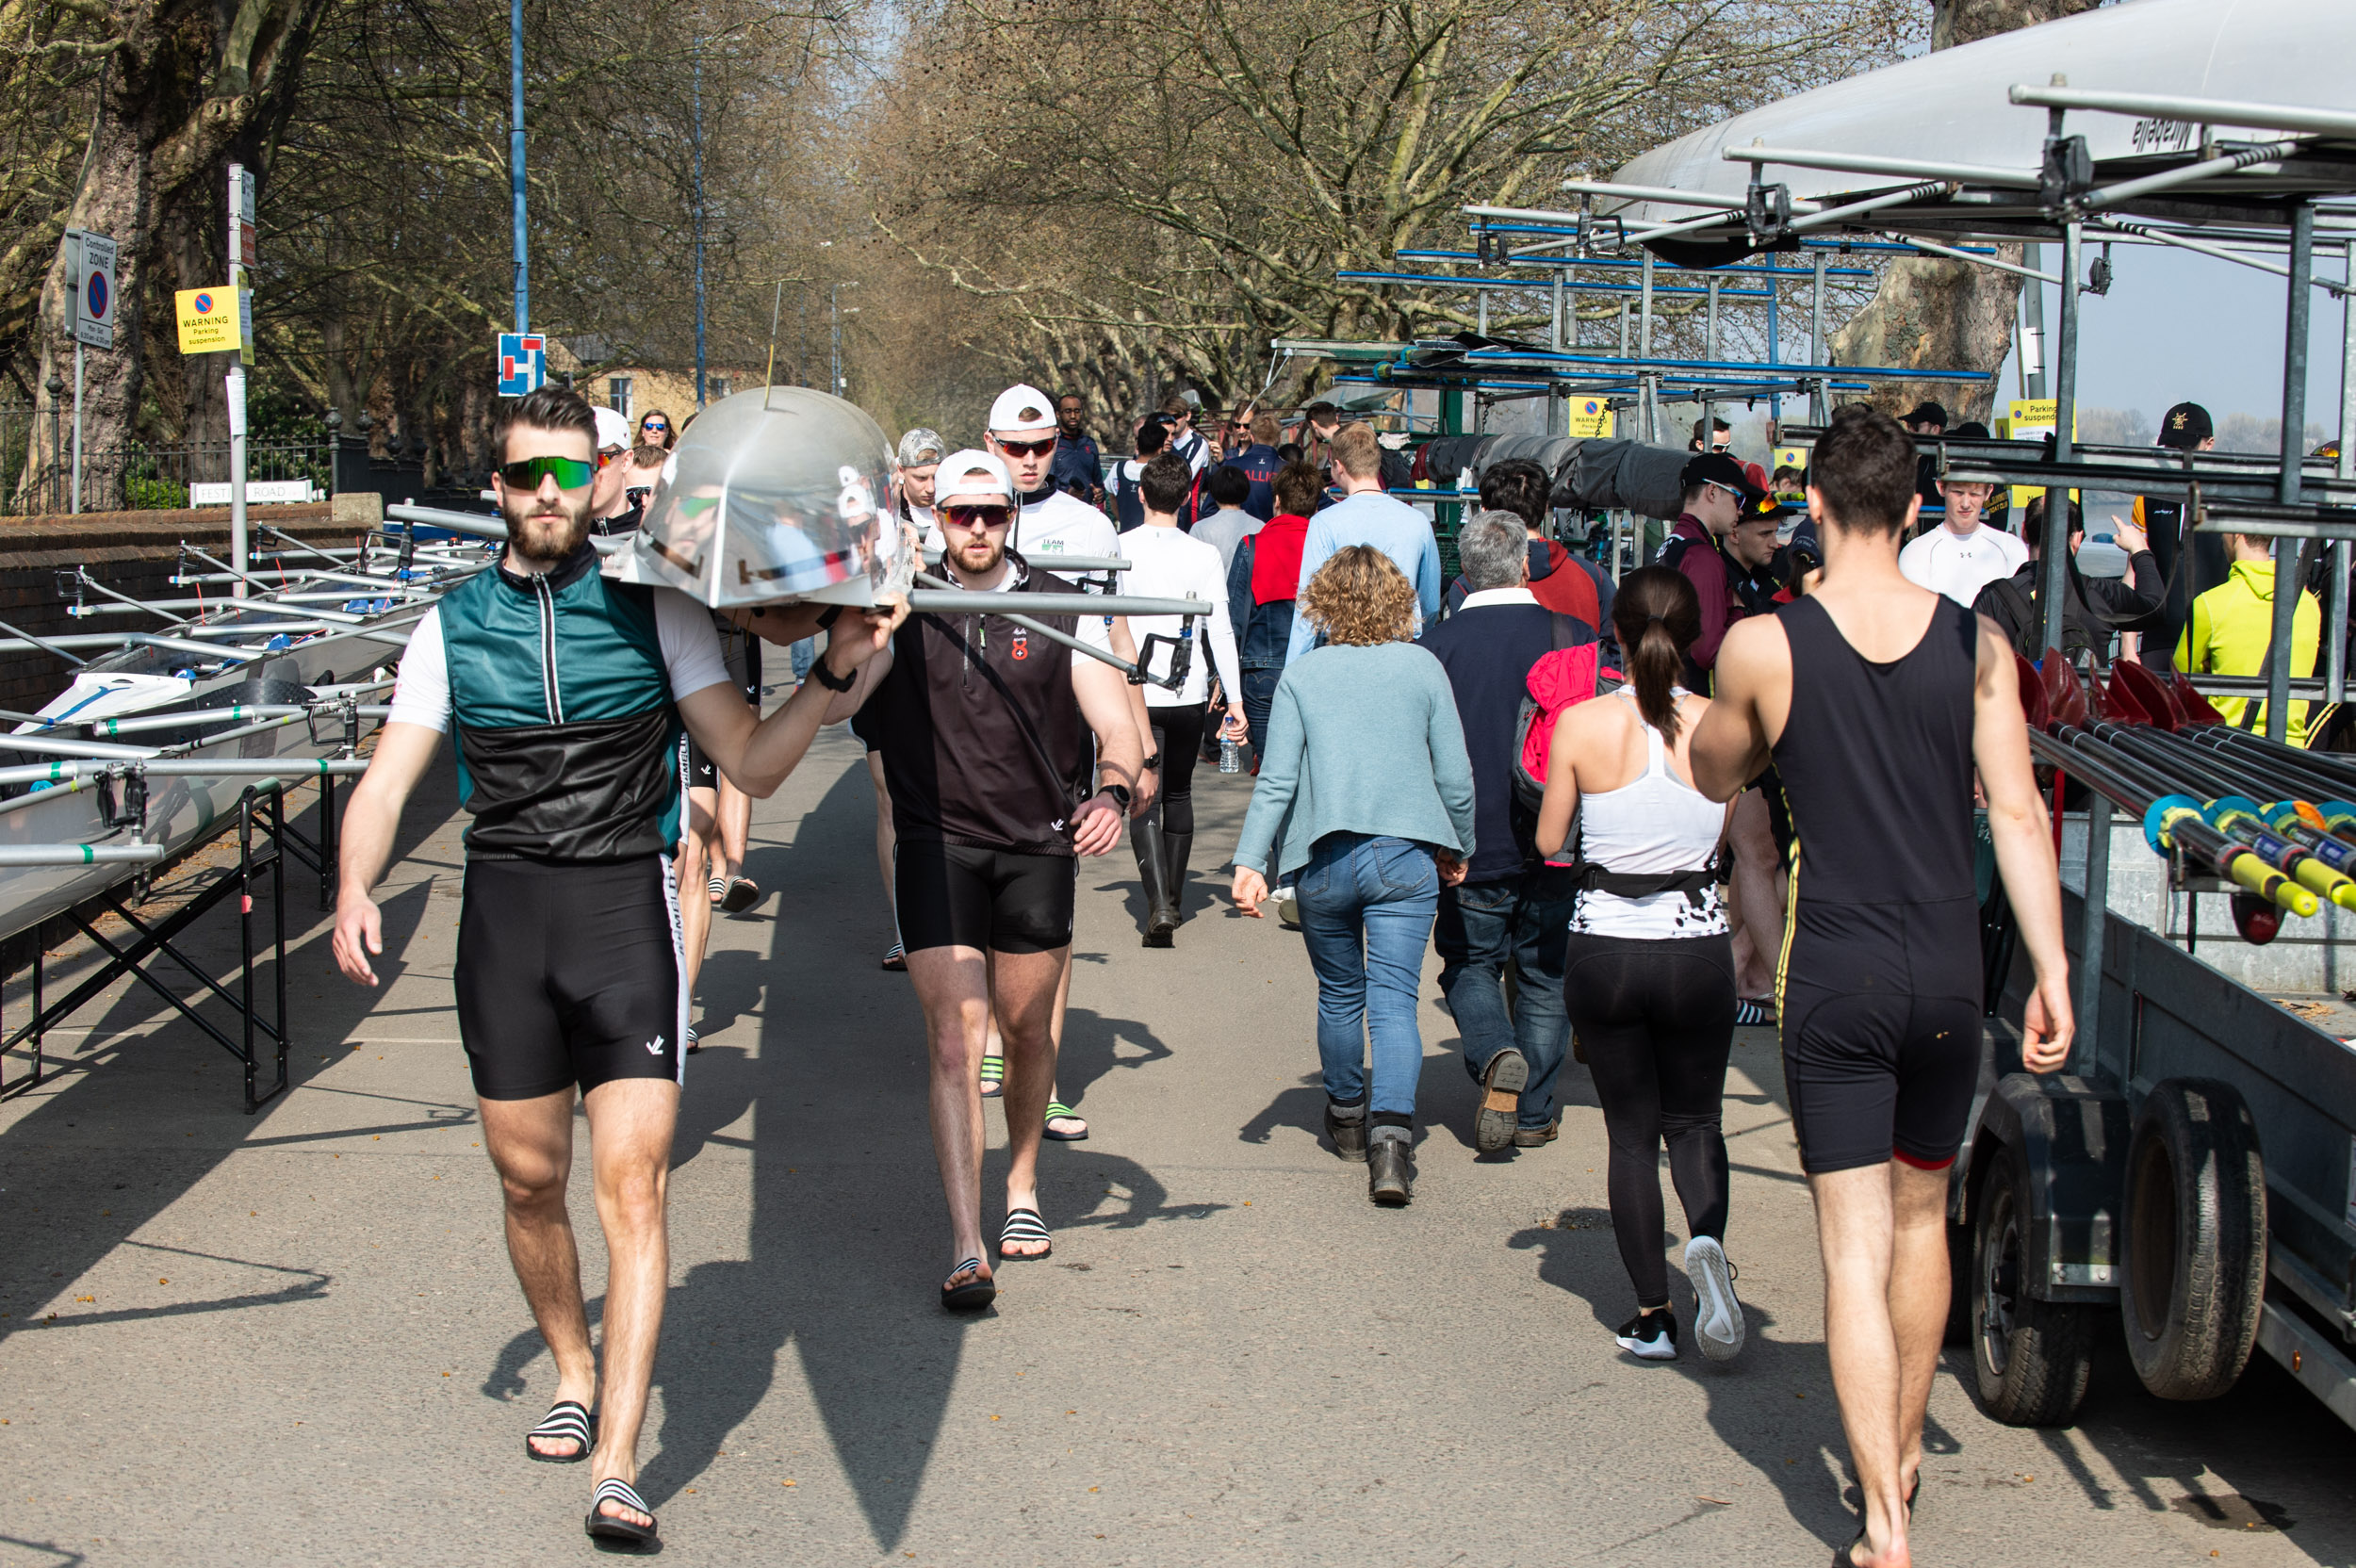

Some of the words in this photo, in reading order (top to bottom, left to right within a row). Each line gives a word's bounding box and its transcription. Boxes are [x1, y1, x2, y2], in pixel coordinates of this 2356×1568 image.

[2133, 120, 2194, 153] Mirabella
[86, 237, 113, 254] Controlled
[89, 252, 109, 270] ZONE
[183, 316, 229, 328] WARNING
[193, 327, 219, 335] Parking
[188, 335, 226, 345] suspension
[254, 486, 286, 498] ROAD
